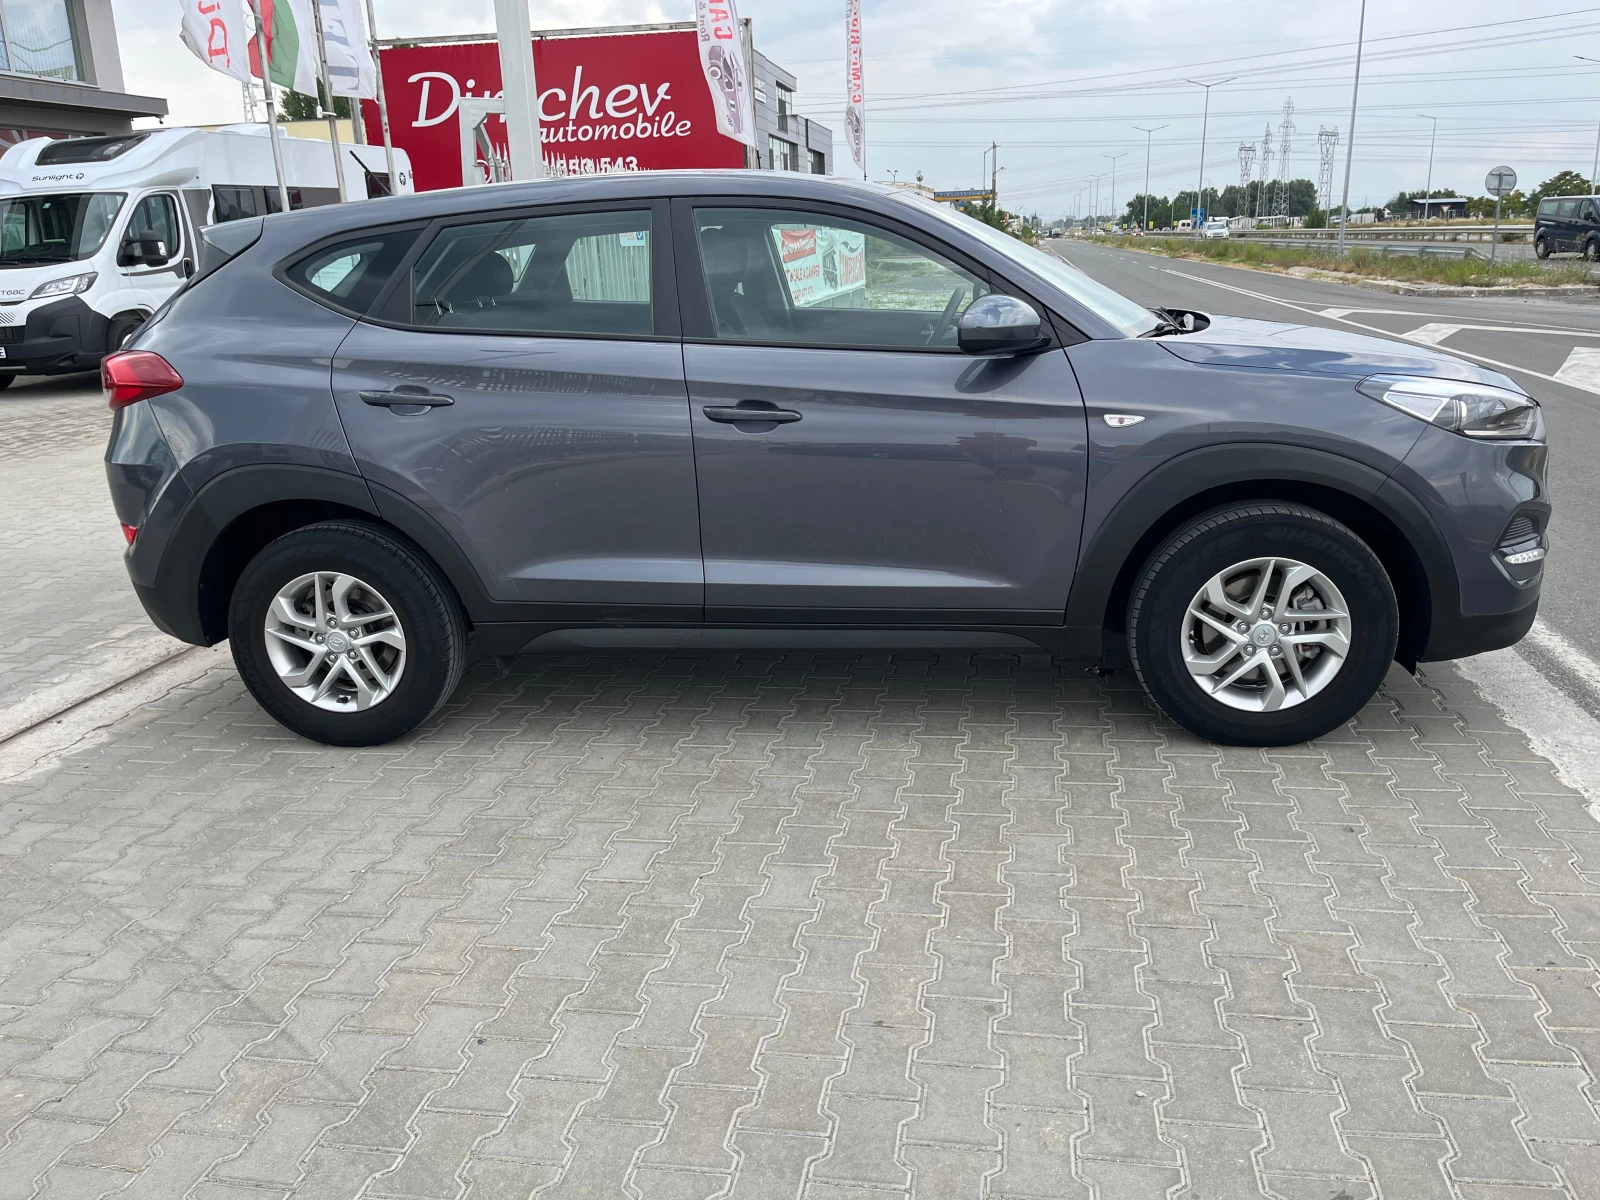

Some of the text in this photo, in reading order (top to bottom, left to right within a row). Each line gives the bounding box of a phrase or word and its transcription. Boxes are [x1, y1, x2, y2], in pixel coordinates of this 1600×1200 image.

[407, 65, 672, 128] Dichev
[538, 112, 692, 144] automobile
[31, 173, 74, 182] Sunlight
